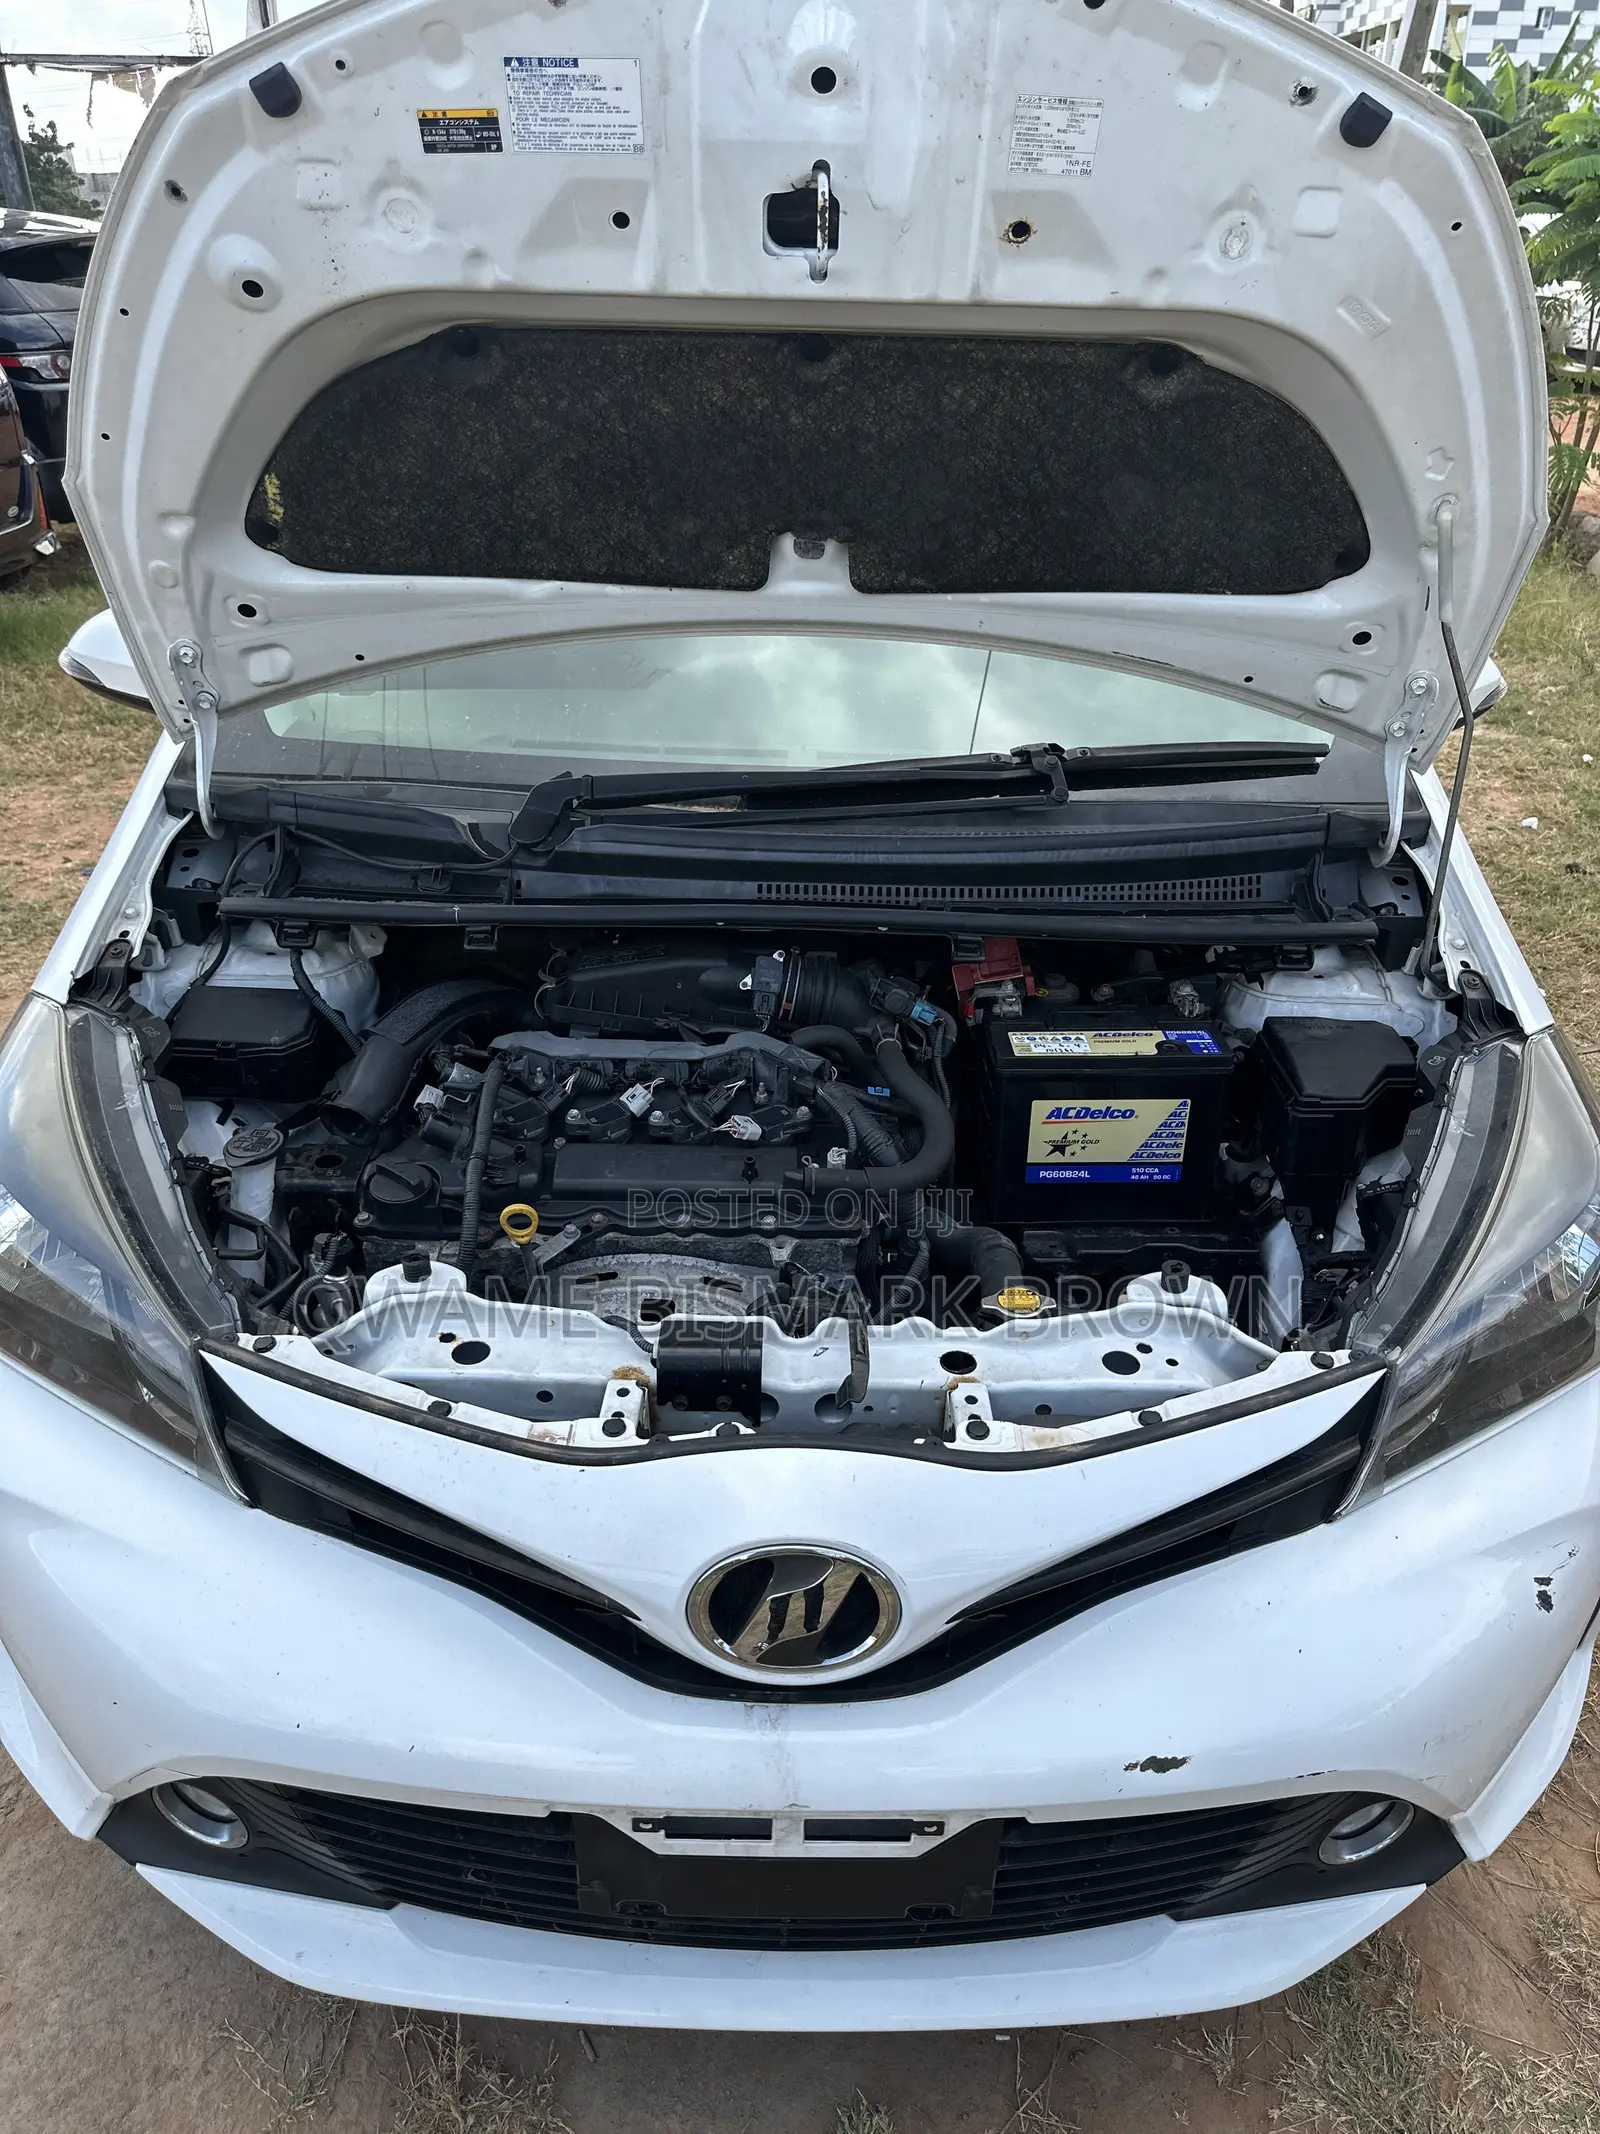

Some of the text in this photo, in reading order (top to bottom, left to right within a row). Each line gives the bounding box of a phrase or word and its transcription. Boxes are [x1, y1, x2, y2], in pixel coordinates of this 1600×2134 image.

[543, 58, 575, 67] NOTICE
[1065, 159, 1092, 168] 1NR-FE
[1079, 168, 1092, 177] BM
[1045, 1106, 1135, 1120] ACDelco
[1128, 1151, 1182, 1159] ACDelco
[1039, 1170, 1091, 1179] PG60B24L
